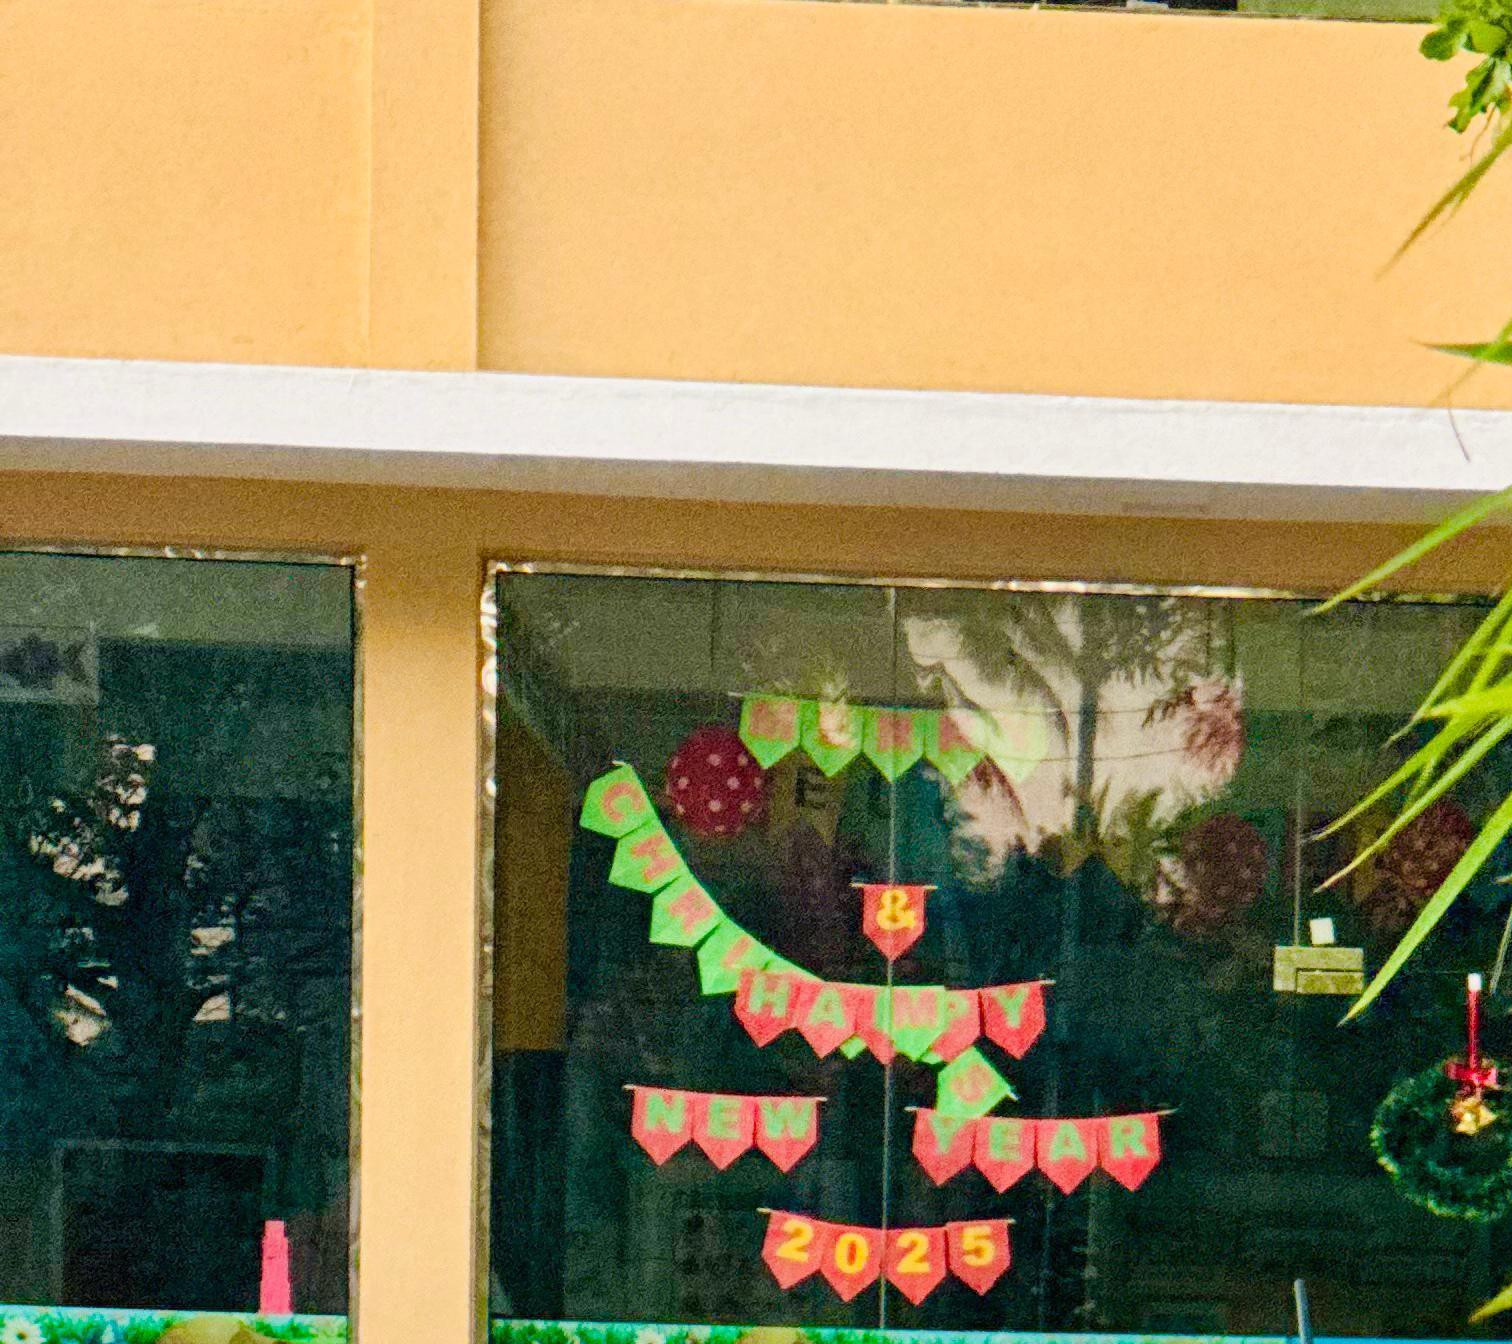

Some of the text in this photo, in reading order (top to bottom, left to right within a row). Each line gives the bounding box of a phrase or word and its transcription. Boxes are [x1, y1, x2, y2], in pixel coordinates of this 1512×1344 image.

[876, 889, 917, 931] &
[643, 1093, 1149, 1162] NEW YEAR
[775, 1218, 996, 1275] 2025
